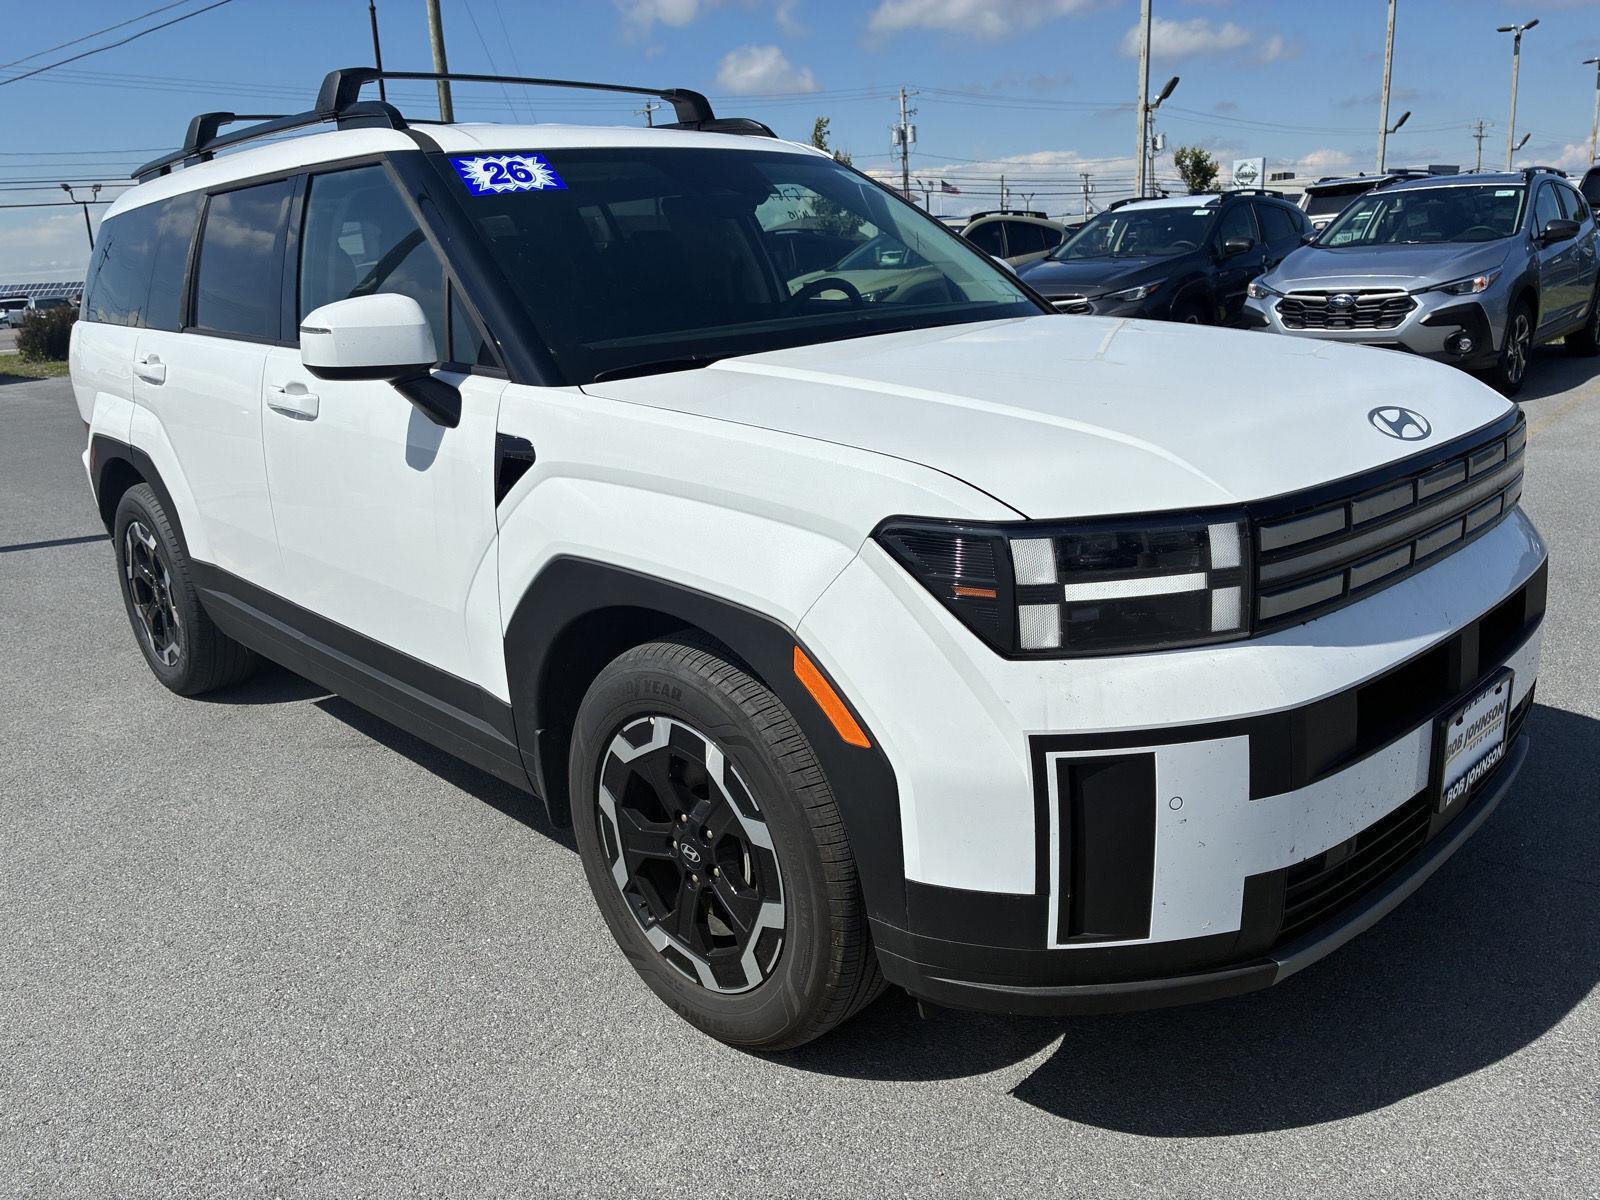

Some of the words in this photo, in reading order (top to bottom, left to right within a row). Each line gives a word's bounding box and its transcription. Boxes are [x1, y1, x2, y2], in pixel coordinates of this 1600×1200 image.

[483, 161, 534, 185] 26
[1448, 732, 1463, 757] BOB
[1464, 699, 1506, 748] JOHNSON
[1446, 778, 1465, 806] BOB
[1465, 743, 1504, 793] JOHNSON
